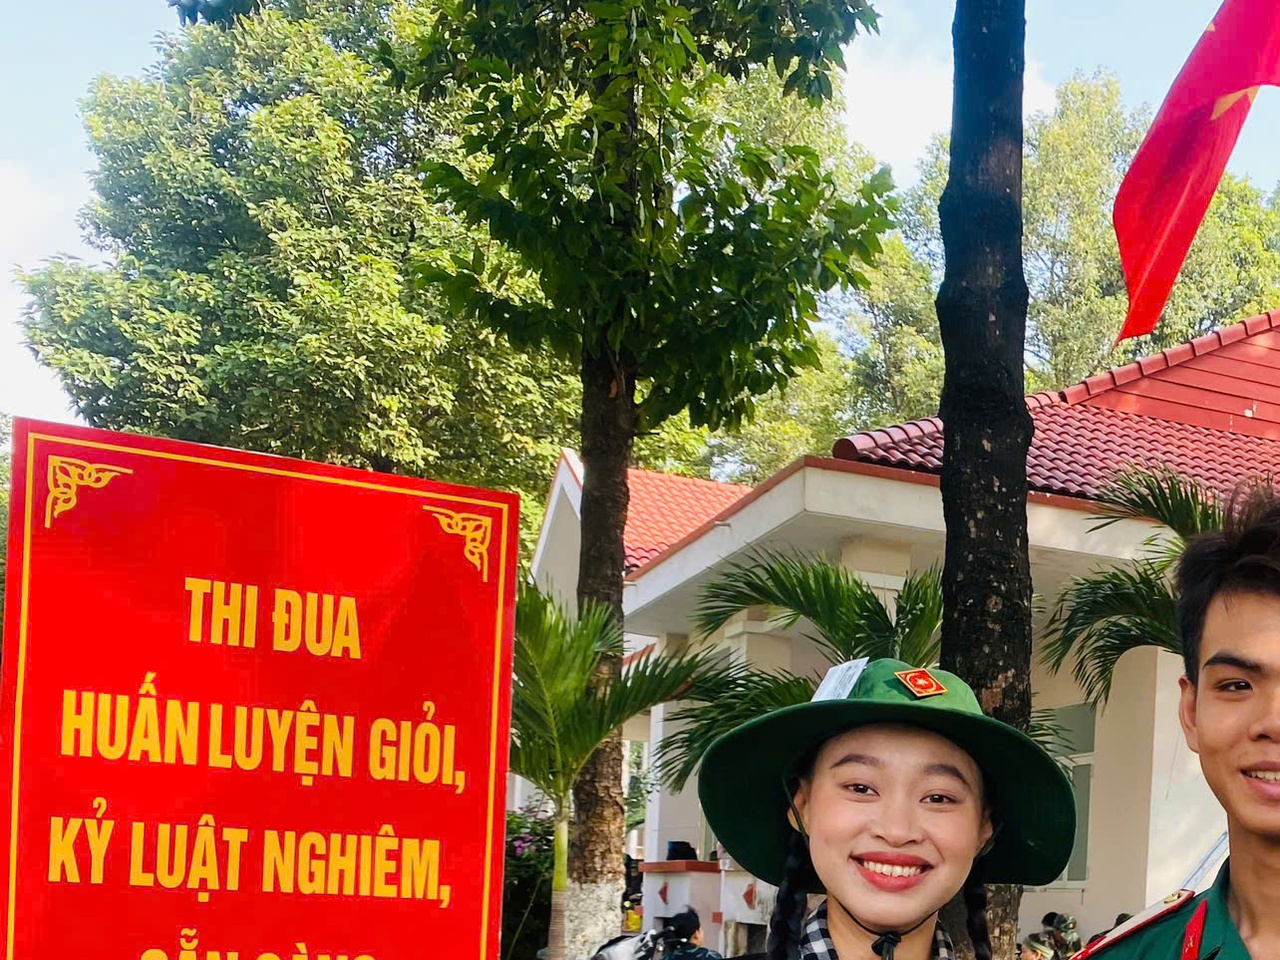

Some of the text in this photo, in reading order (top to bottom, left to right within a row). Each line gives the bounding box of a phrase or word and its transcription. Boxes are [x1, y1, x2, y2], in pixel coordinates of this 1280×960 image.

[185, 578, 360, 658] THI ĐUA
[61, 672, 464, 793] HUẤN LUYỆN GIỎI,
[49, 797, 450, 907] KỶ LUẬT NGHIÊM,
